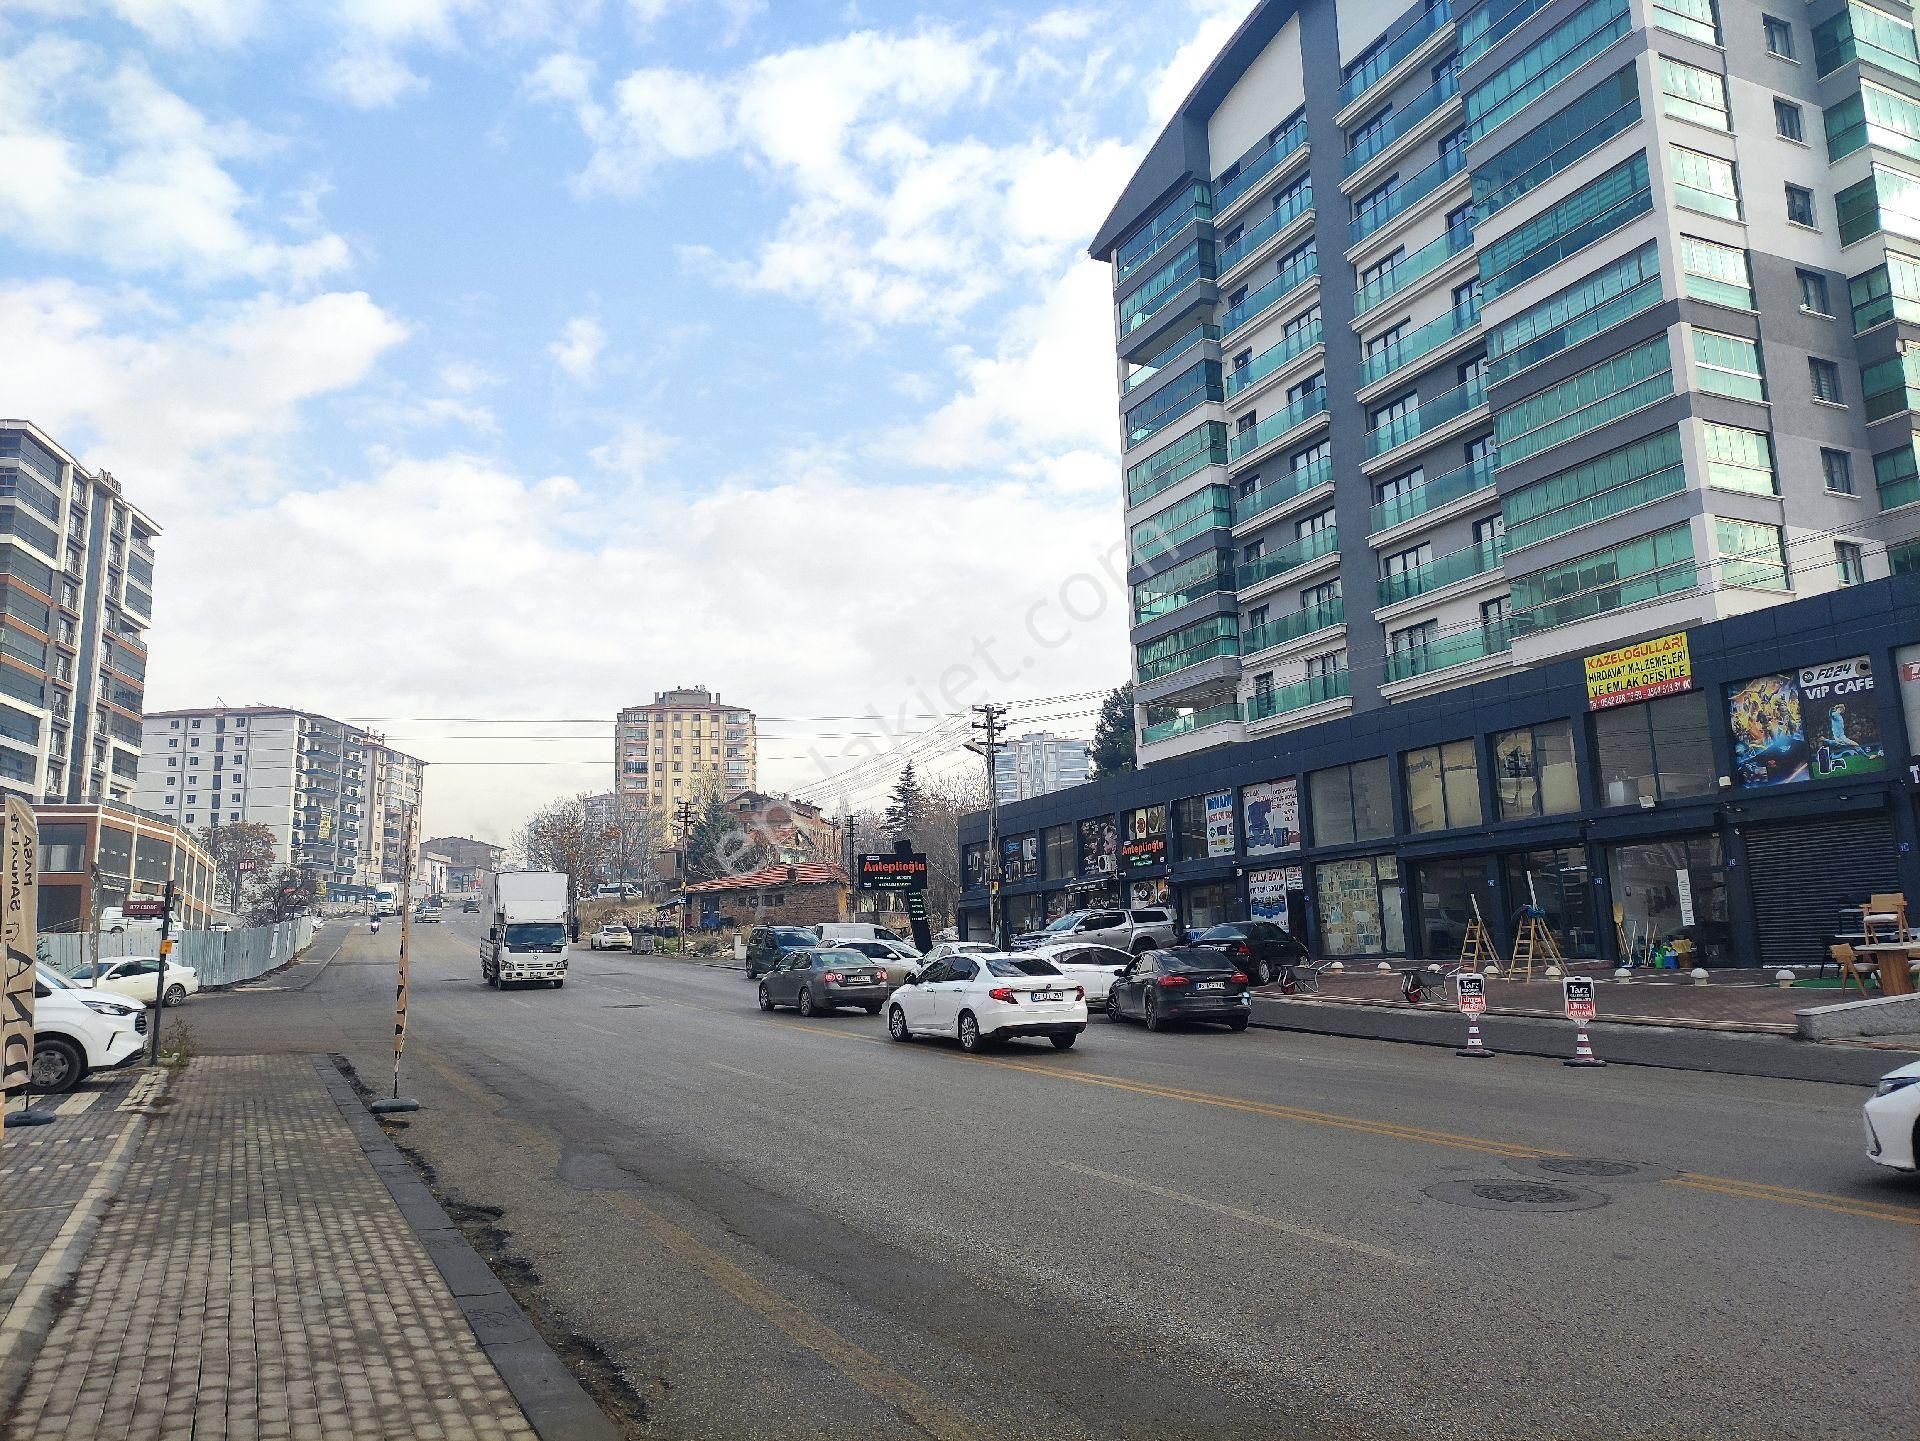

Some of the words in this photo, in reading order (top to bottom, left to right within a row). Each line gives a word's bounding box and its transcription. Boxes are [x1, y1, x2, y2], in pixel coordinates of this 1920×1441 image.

[1587, 636, 1684, 669] KAZELOĞULLARI
[1588, 665, 1626, 683] HIRDAVAT
[1628, 647, 1686, 674] MALZEMELERİ
[1592, 684, 1605, 696] VE
[1606, 677, 1639, 693] EMLAK
[1642, 668, 1668, 684] OFİSİ
[1834, 677, 1874, 695] CAFE
[863, 861, 925, 873] Anteplioğlu
[1570, 985, 1588, 994] Tarz
